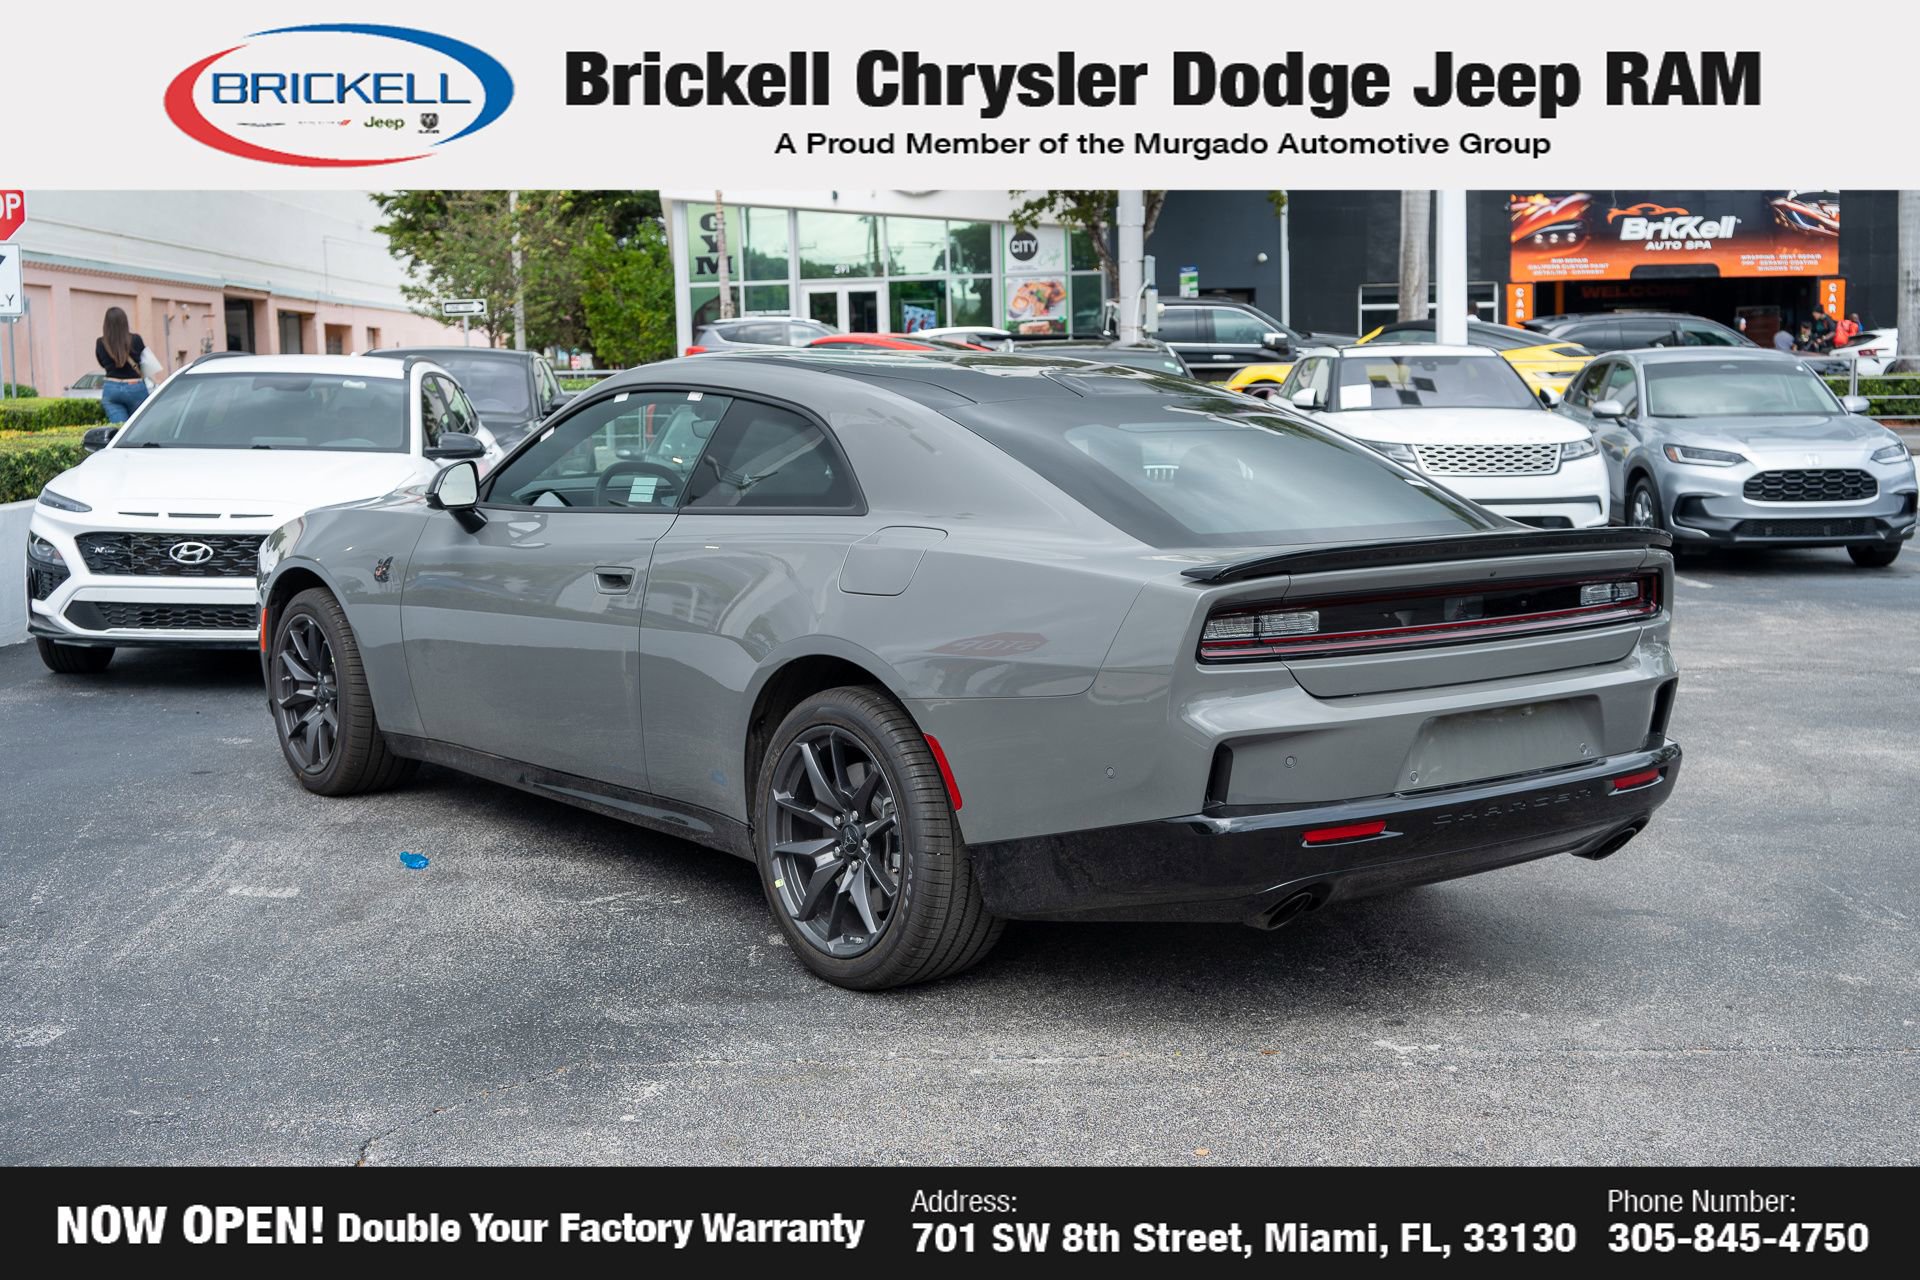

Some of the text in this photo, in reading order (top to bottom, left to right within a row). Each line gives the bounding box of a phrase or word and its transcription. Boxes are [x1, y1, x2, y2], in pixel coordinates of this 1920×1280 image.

[1010, 240, 1038, 253] CITY
[1645, 240, 1712, 251] AUTO SPA
[1515, 287, 1525, 318] CAR
[1827, 282, 1837, 313] CAR
[1433, 788, 1592, 825] CHARGER
